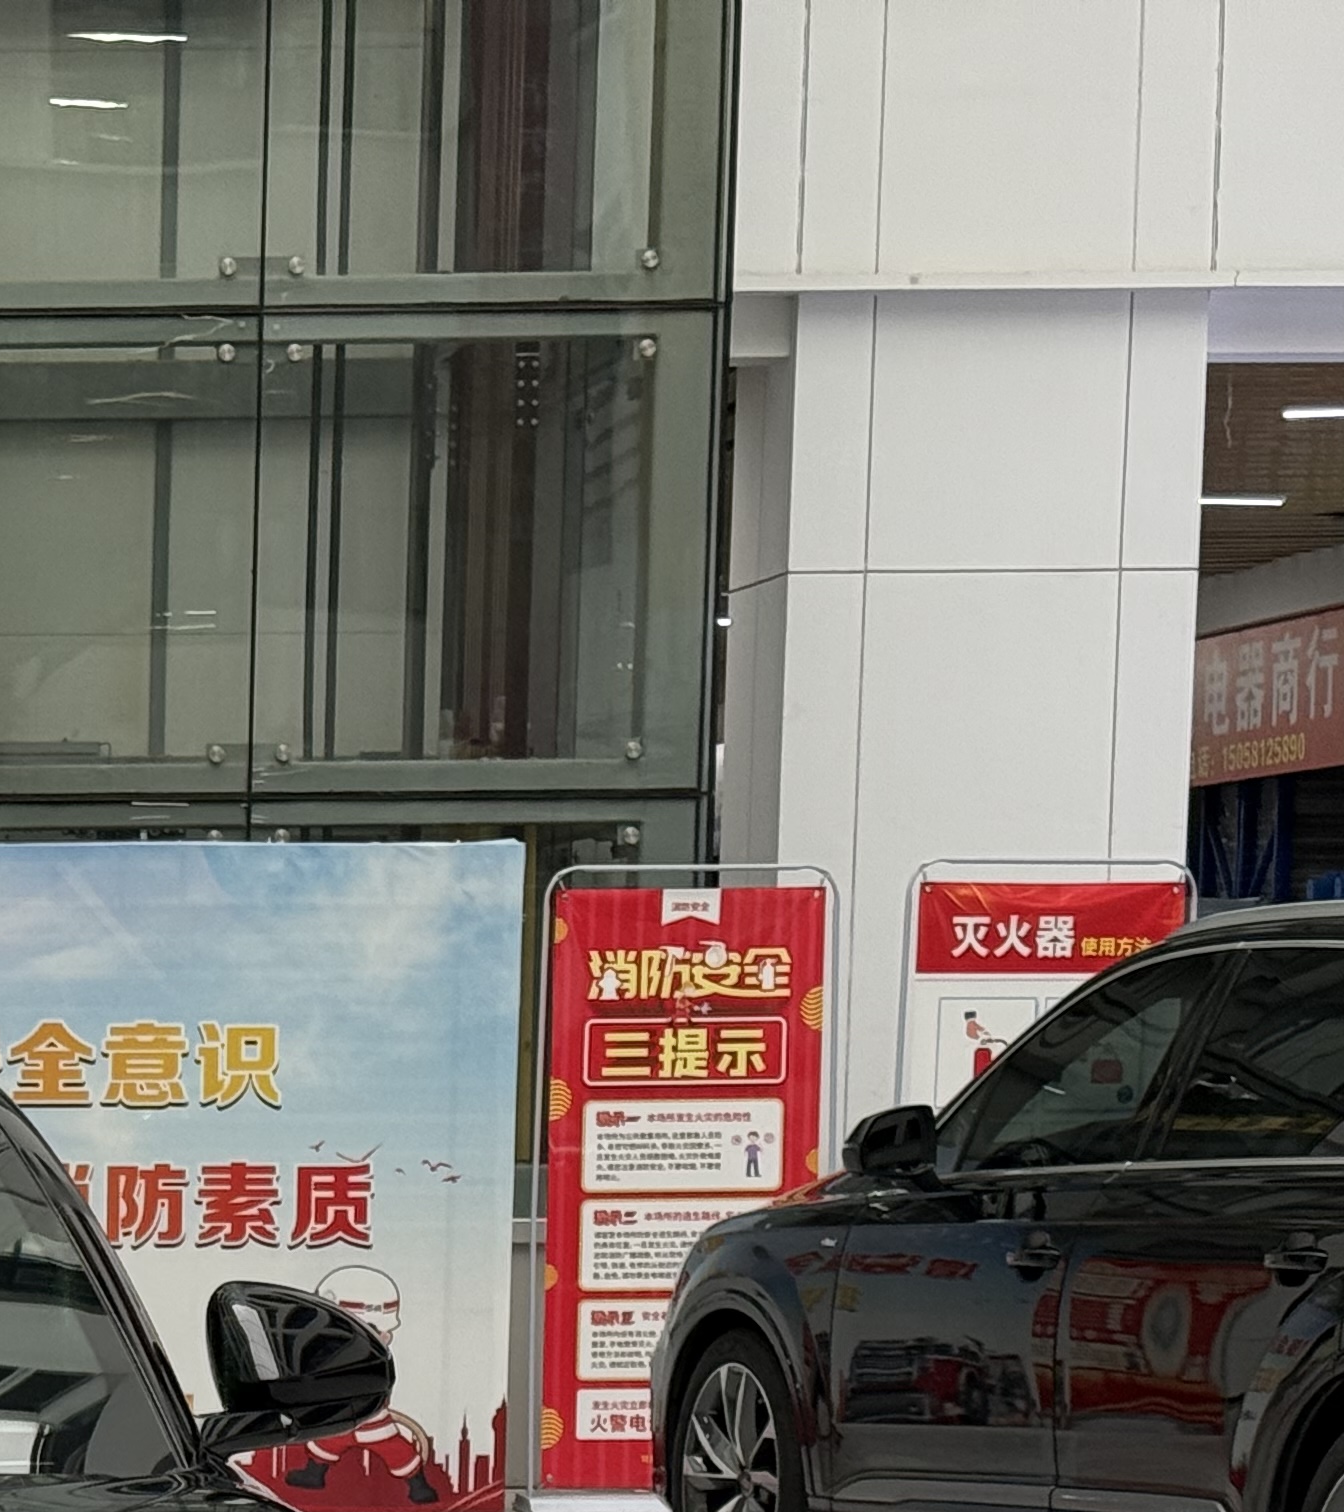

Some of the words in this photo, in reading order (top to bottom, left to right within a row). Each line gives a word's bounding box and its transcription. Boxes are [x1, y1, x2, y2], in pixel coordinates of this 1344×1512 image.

[1204, 625, 1339, 736] 电器商行
[951, 914, 1075, 958] 灭火器
[1080, 936, 1153, 957] 使用方法
[587, 942, 792, 1001] 消防安全
[601, 1028, 768, 1078] 三提示
[62, 1162, 373, 1250] 防素质
[590, 1415, 652, 1433] 火警电
